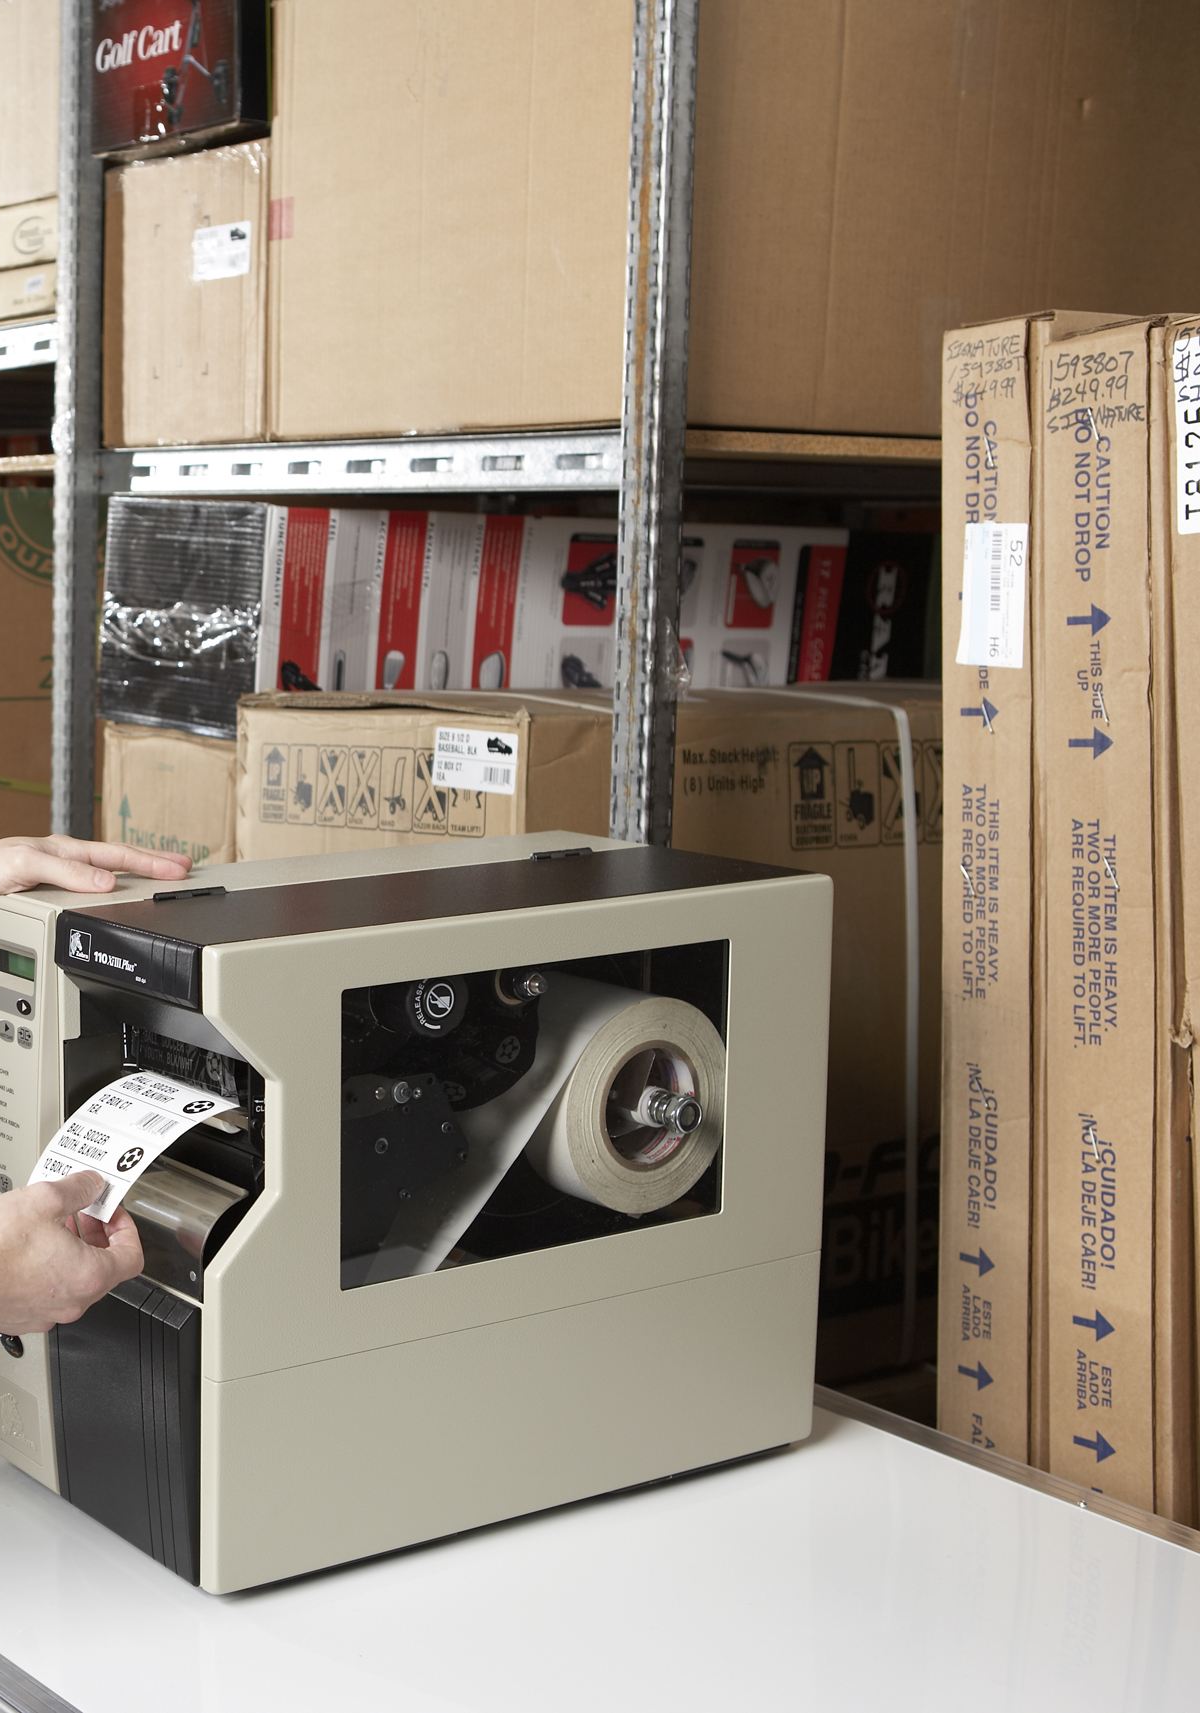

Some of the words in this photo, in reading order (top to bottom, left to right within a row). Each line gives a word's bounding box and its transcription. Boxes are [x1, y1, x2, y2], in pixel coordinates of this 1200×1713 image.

[95, 30, 138, 73] Golf
[137, 20, 182, 61] Cart
[1049, 350, 1135, 390] 1593807
[1074, 407, 1091, 443] DO
[965, 436, 980, 484] NOT
[1074, 452, 1091, 503] NOT
[965, 494, 980, 524] DR
[1095, 435, 1111, 550] CAUTION
[1010, 540, 1024, 567] 52
[1074, 512, 1090, 583] DROP
[978, 664, 989, 690] IDE
[1090, 640, 1102, 677] THIS
[1077, 669, 1089, 692] UP
[962, 784, 973, 822] ARE
[975, 784, 986, 826] TWO
[988, 800, 999, 841] THIS
[191, 843, 210, 864] UP
[975, 834, 986, 859] OR
[1072, 819, 1085, 858] ARE
[1087, 819, 1101, 864] TWO
[1103, 835, 1117, 878] THIS
[988, 847, 999, 890] ITEM
[1087, 871, 1101, 898] OR
[975, 867, 986, 919] MORE
[988, 897, 999, 914] IS
[1104, 885, 1117, 931] ITEM
[1072, 867, 1085, 967] REQUIRED
[1087, 906, 1101, 962] MORE
[962, 931, 973, 953] TO
[975, 927, 986, 999] PEOPLE
[988, 920, 999, 986] HEAVY.
[1104, 938, 1117, 955] IS
[414, 983, 427, 1025] RELEASE
[1073, 973, 1086, 998] TO
[1104, 961, 1118, 1032] HEAVY.
[1073, 1005, 1086, 1049] LIFT.
[1088, 969, 1101, 1046] PEOPLE
[968, 1098, 981, 1120] LA
[83, 1129, 110, 1146] SOCCER
[968, 1126, 981, 1170] DEJE
[983, 1087, 999, 1210] ¡CUIDADO!
[50, 1160, 65, 1174] BOX
[1081, 1151, 1097, 1174] LA
[967, 1175, 981, 1229] CAER!
[1081, 1180, 1097, 1229] DEJE
[1097, 1139, 1116, 1270] ¡CUIDADO!
[1081, 1233, 1097, 1291] CAER!
[961, 1284, 971, 1342] ARRIBA
[972, 1295, 981, 1339] LADO
[982, 1300, 992, 1340] ESTE
[1076, 1349, 1088, 1411] ARRIBA
[1089, 1361, 1100, 1407] LADO
[1101, 1366, 1112, 1409] ESTE
[971, 1413, 983, 1445] FAL
